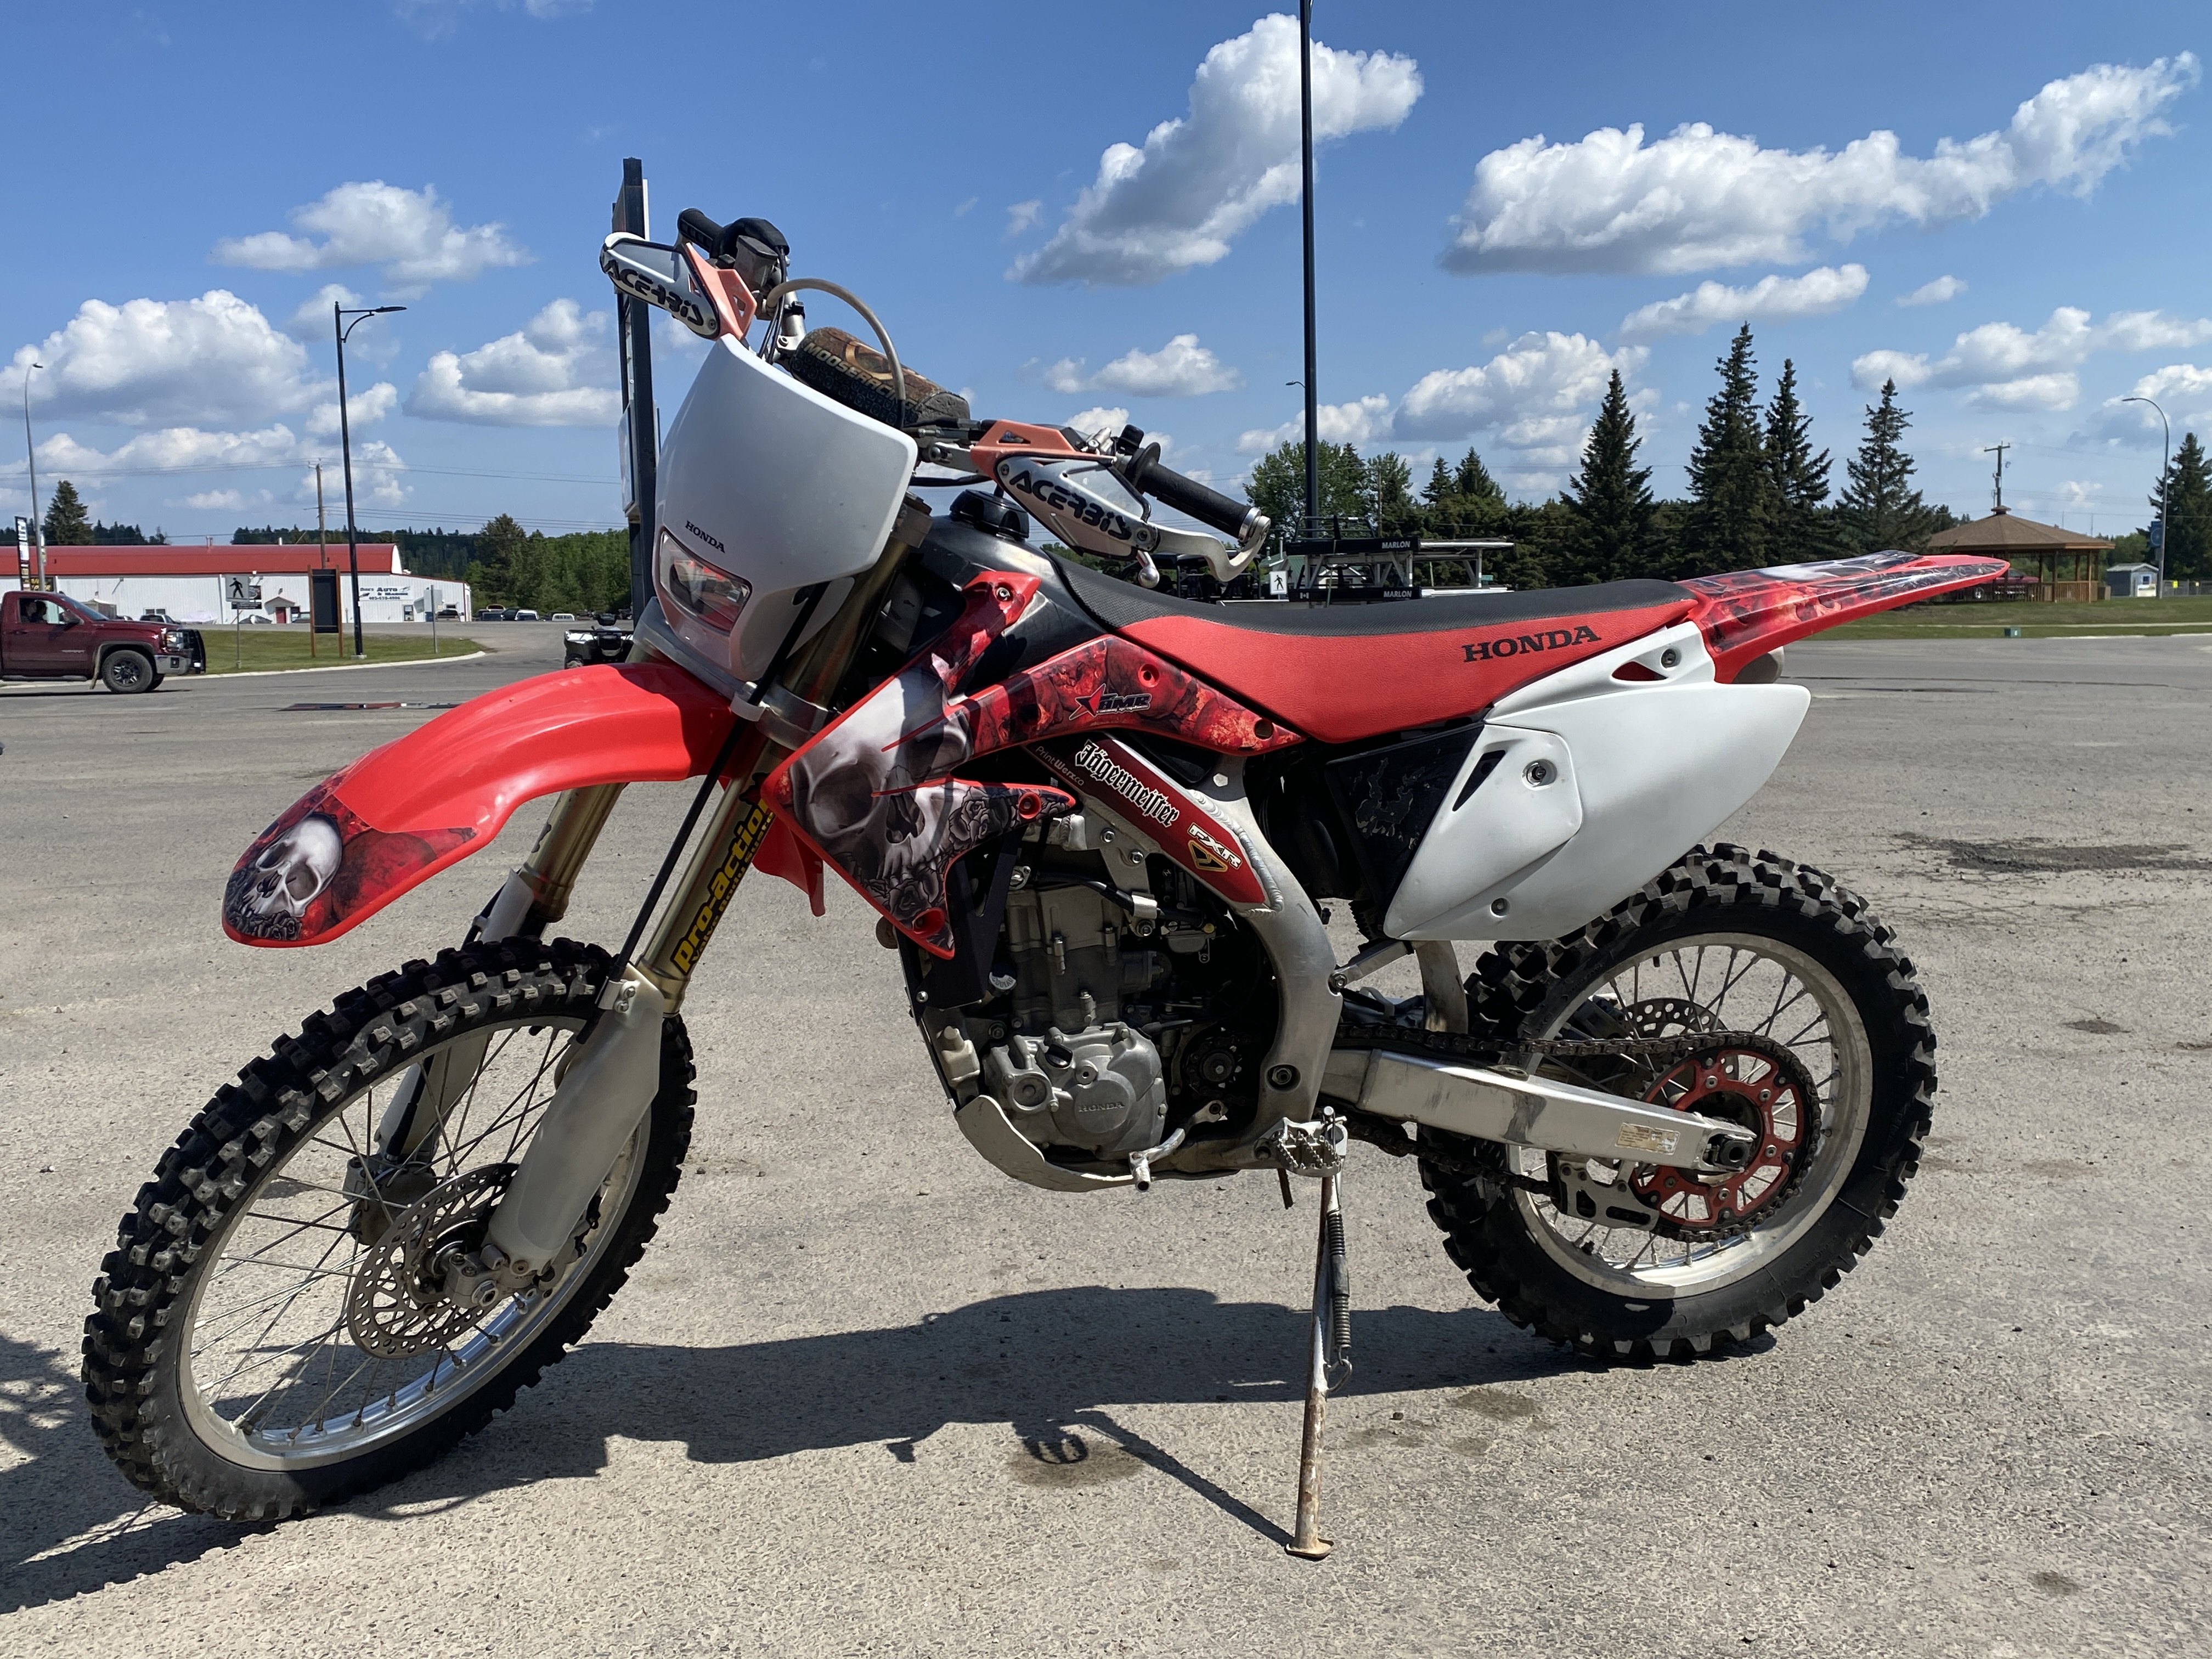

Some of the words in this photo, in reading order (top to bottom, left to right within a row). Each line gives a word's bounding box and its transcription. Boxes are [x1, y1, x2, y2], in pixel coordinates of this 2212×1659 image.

[603, 259, 704, 326] ACERBIS
[1009, 470, 1132, 540] ACERBIS
[685, 520, 725, 553] HONDA
[1462, 625, 1601, 662] HONDA
[1188, 823, 1242, 869] FXR
[1079, 1102, 1125, 1113] HONDA
